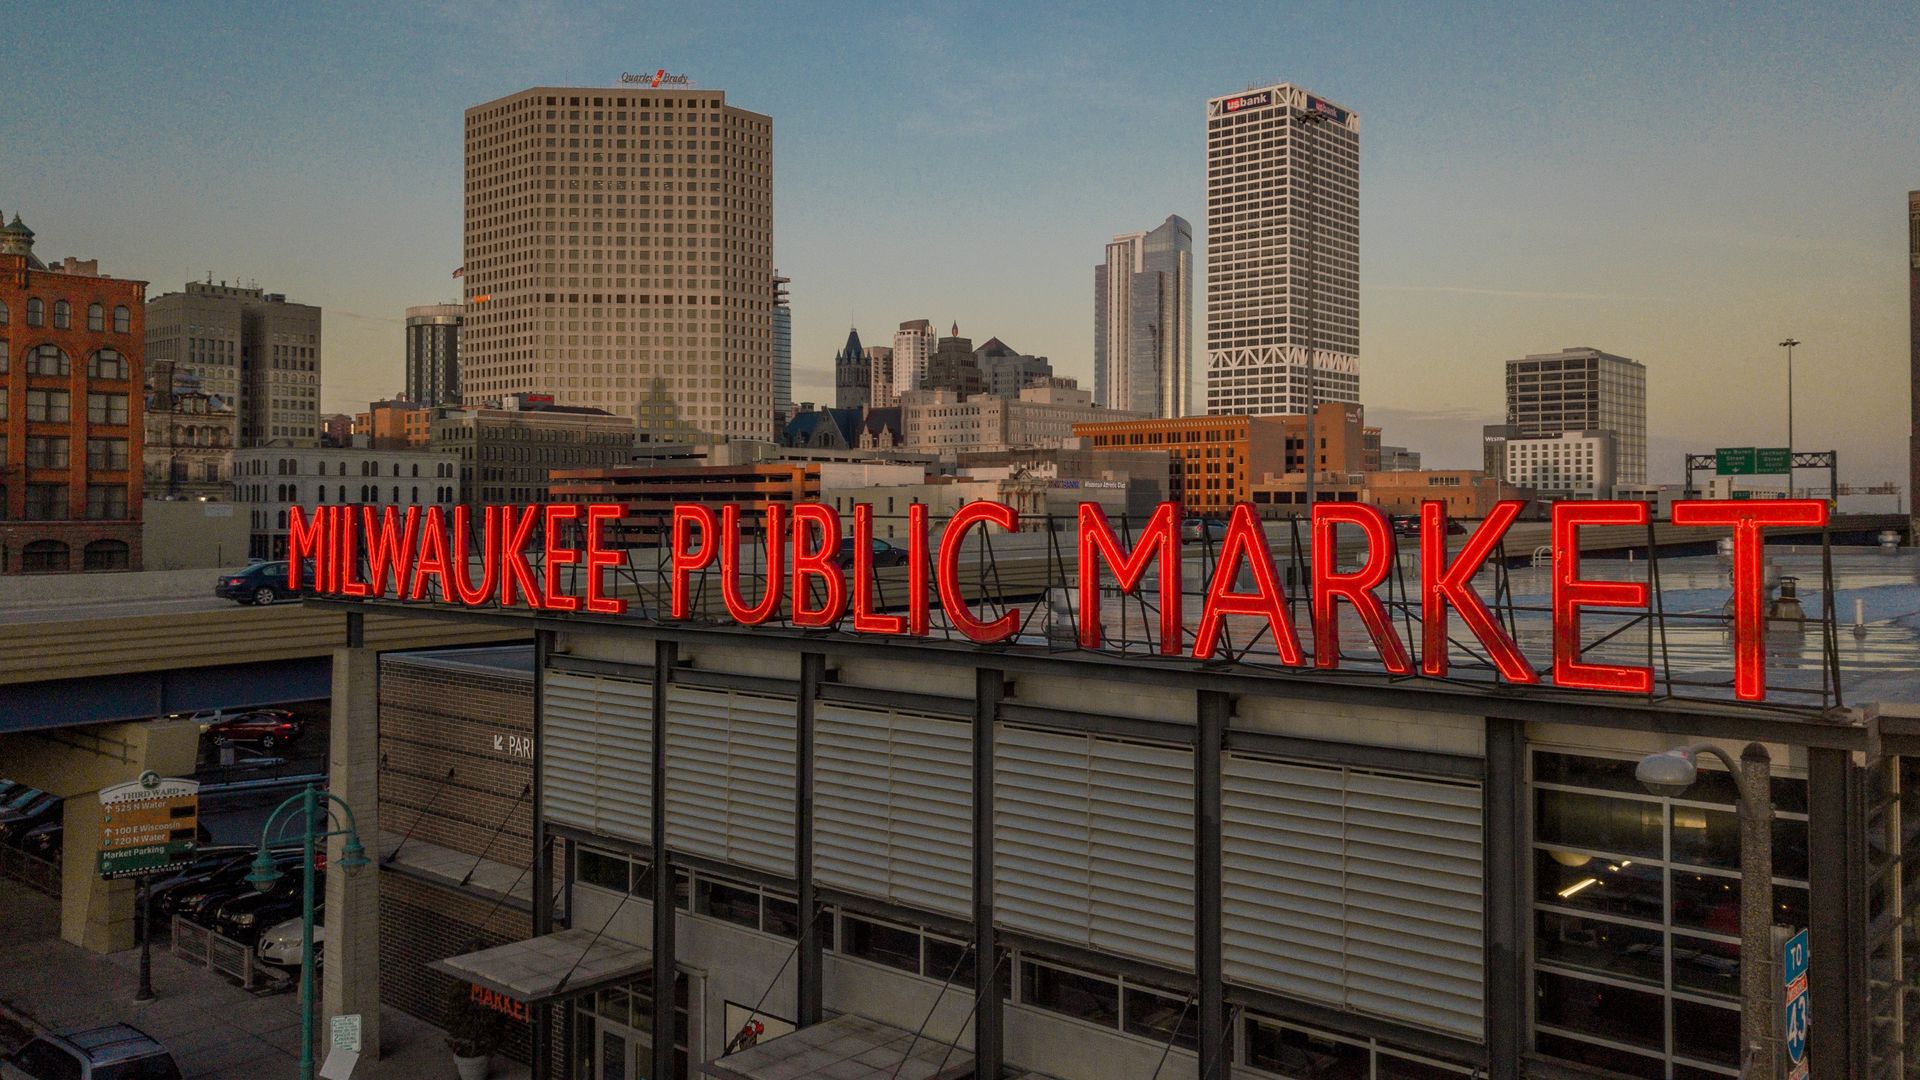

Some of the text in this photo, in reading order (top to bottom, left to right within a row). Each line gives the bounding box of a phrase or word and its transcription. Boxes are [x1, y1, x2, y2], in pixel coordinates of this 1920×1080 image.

[621, 72, 653, 83] Quarles
[663, 72, 688, 84] Brady
[288, 499, 1830, 701] MILWAUKEE PUBLIC MARKET
[122, 787, 180, 800] THIRD WARD
[115, 801, 166, 813] 525 N Water
[115, 822, 180, 835] 100 E Wisconsin
[115, 837, 130, 846] 720
[133, 836, 140, 844] N
[140, 833, 165, 842] Water
[103, 846, 165, 859] Market Parking
[1791, 943, 1802, 970] TO
[1788, 996, 1806, 1047] 43
